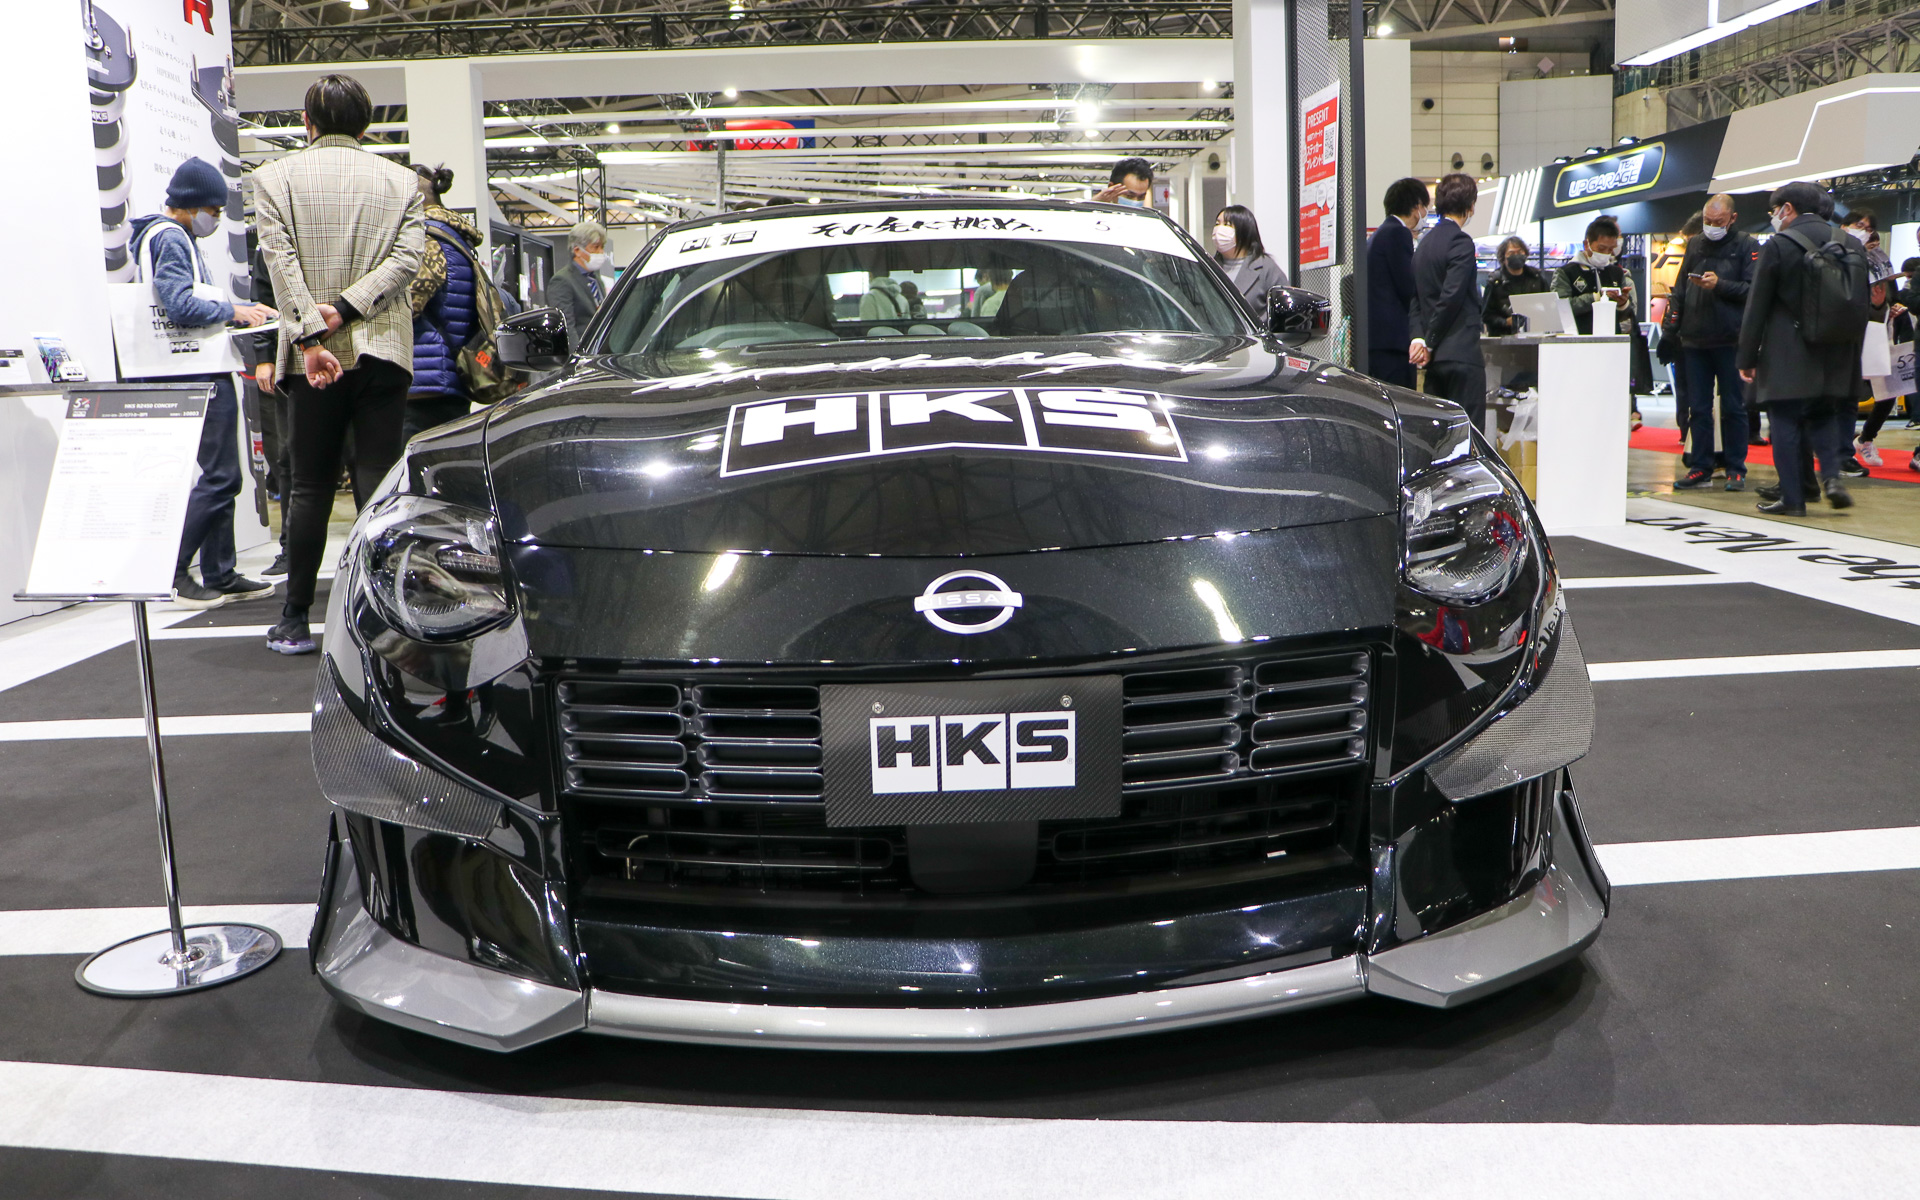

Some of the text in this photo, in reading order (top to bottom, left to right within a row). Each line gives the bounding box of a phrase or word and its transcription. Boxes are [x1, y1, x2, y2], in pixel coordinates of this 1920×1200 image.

[1307, 106, 1330, 129] PRESENT
[170, 341, 199, 353] HKS
[741, 390, 1162, 446] HKS
[876, 718, 1069, 768] HKS
